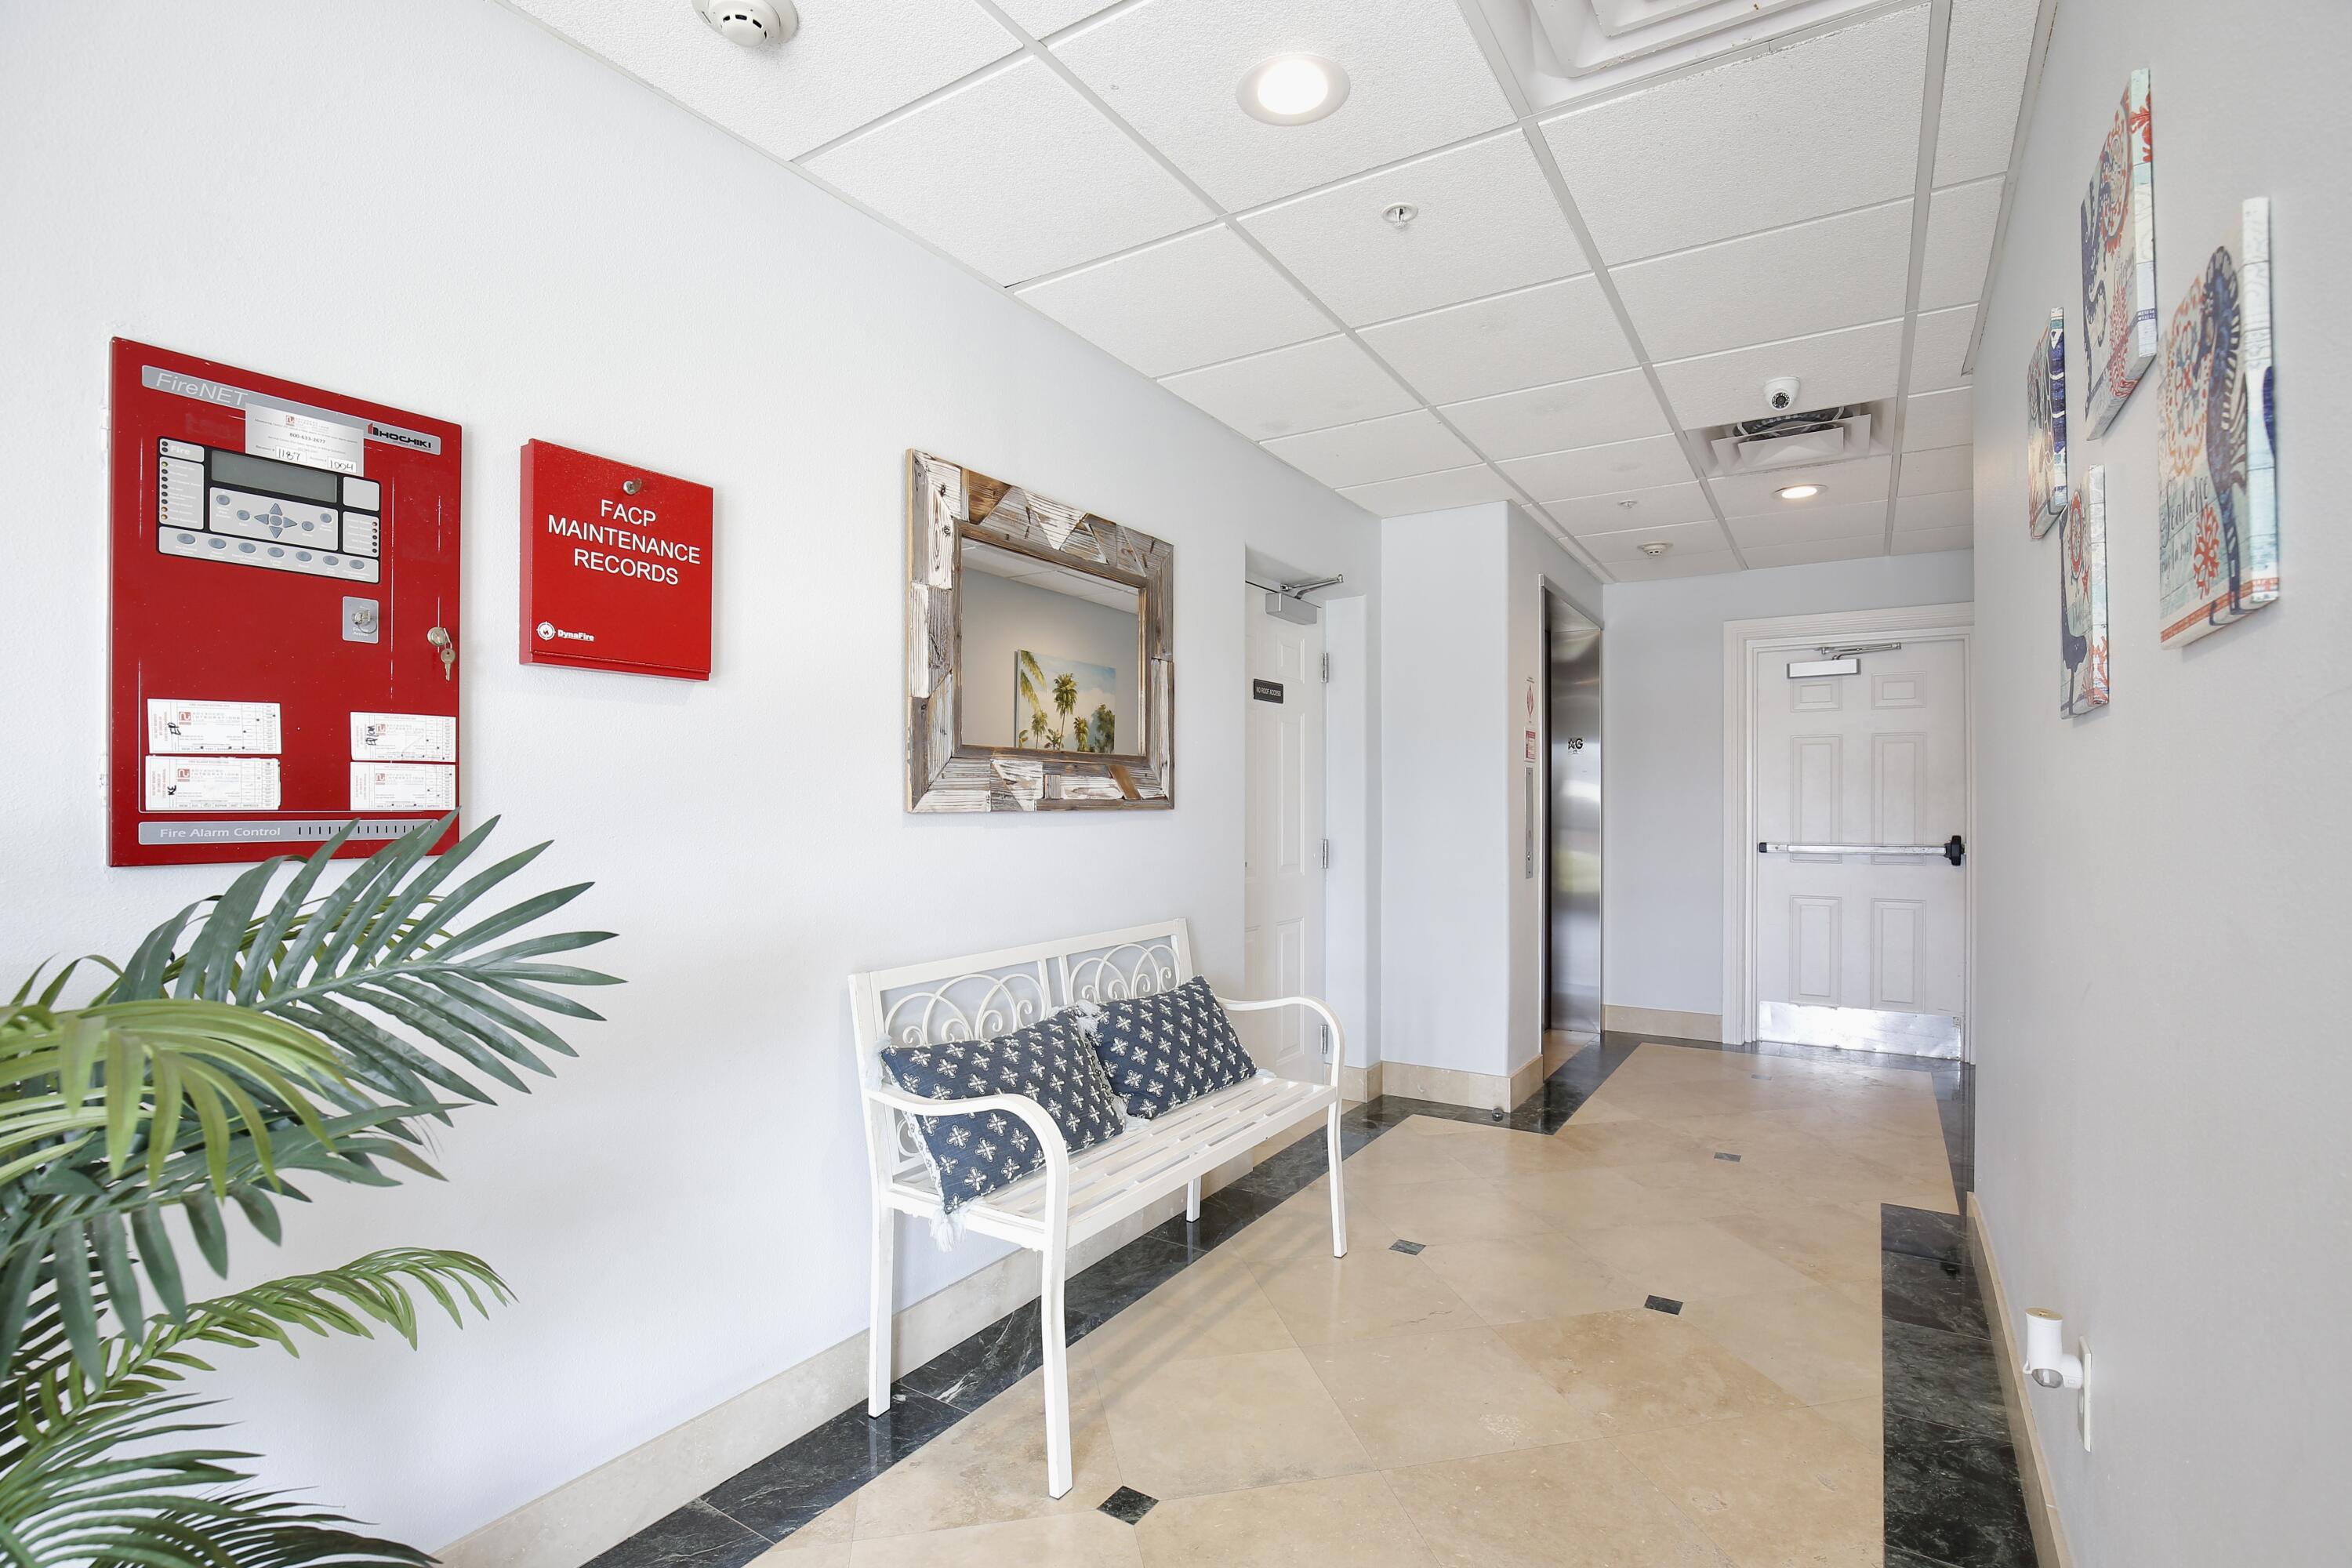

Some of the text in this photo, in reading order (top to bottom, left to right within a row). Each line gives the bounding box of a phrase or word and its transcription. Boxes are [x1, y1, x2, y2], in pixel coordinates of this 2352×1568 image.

[156, 372, 249, 406] FireNET
[379, 430, 431, 448] HOCHIKI
[170, 445, 191, 456] Fire
[278, 448, 300, 461] 1187
[601, 499, 657, 527] FACP
[548, 514, 701, 564] MAINTENANCE
[574, 548, 679, 586] RECORDS
[557, 629, 594, 641] DynaFire
[1576, 738, 1584, 750] G
[160, 827, 281, 838] Fire Alarm Control
